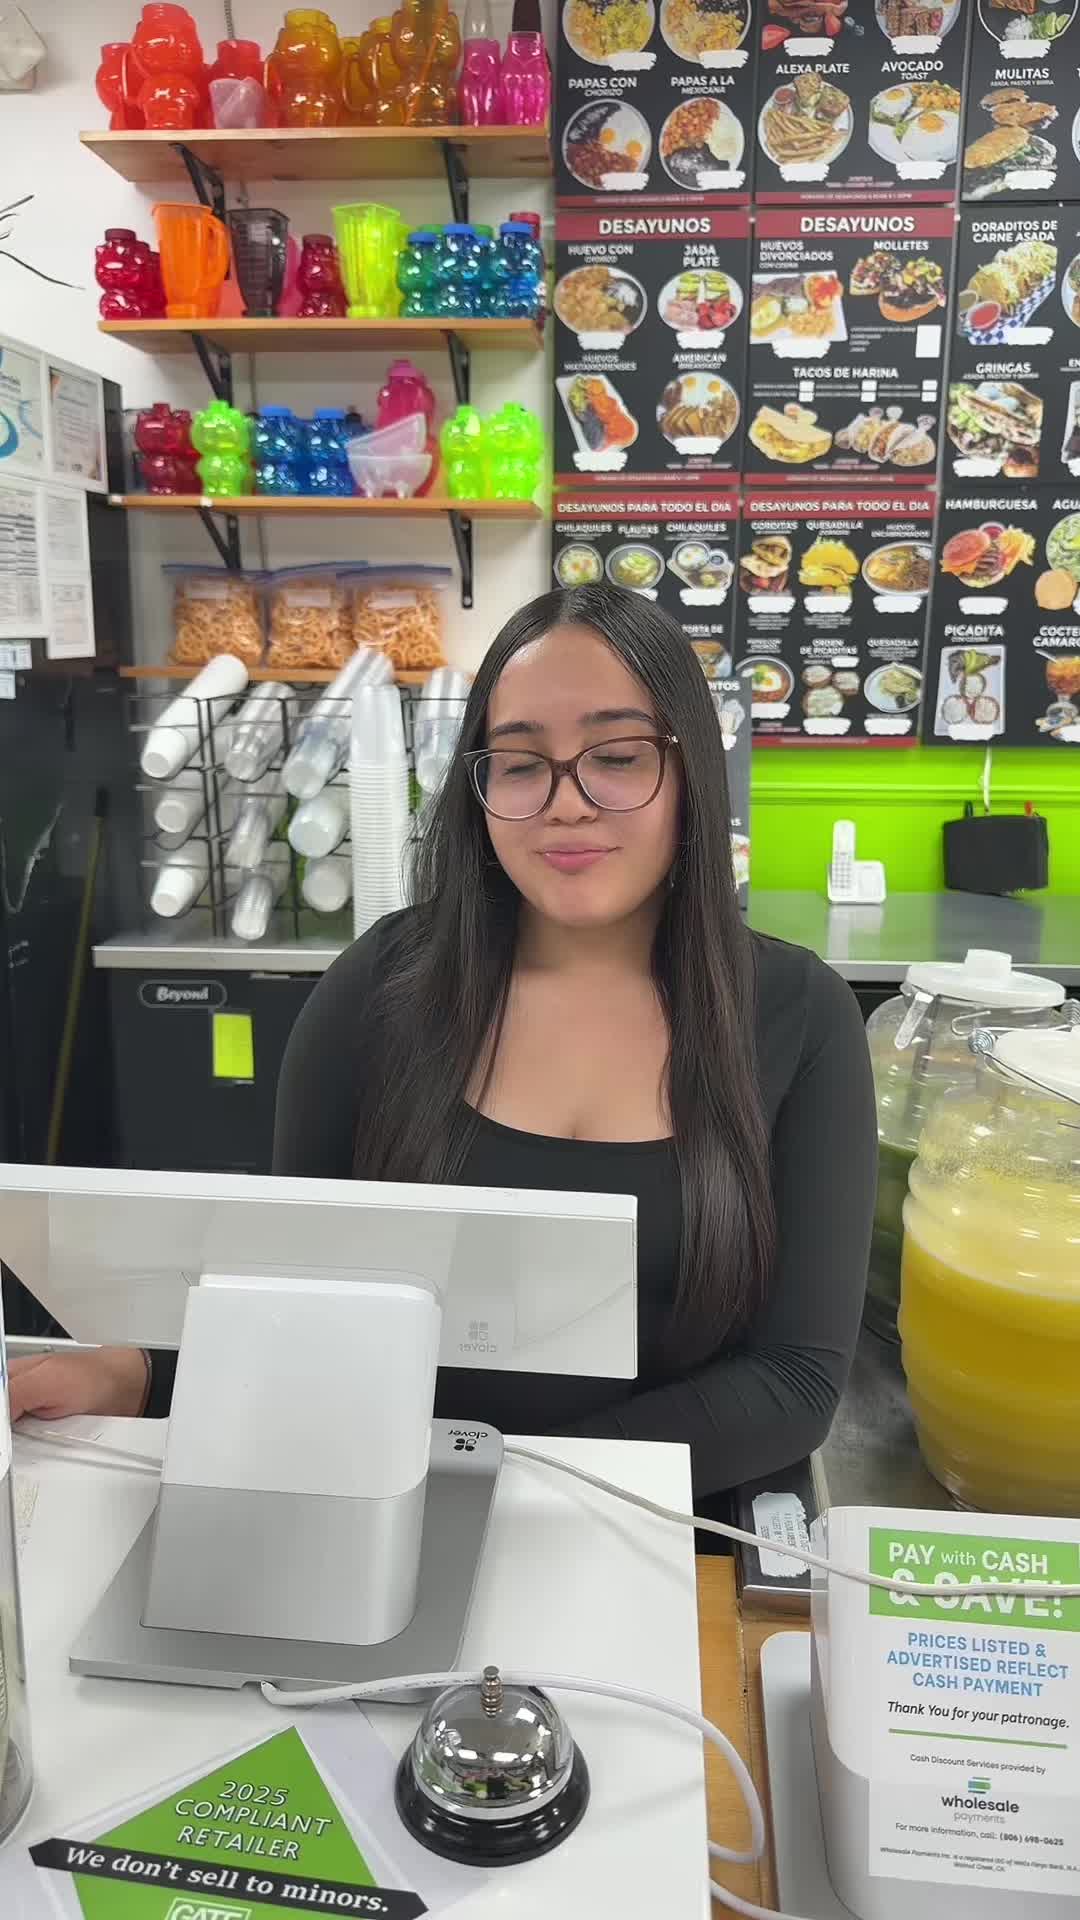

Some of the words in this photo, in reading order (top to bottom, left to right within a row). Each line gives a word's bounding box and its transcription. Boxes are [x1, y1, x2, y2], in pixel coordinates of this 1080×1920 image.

[775, 64, 812, 75] ALEXA
[815, 63, 850, 74] PLATE
[881, 60, 944, 73] AVOCADO
[900, 72, 929, 81] TOAST
[994, 68, 1050, 80] MULITAS
[568, 78, 607, 89] PAPAS
[609, 77, 637, 88] CON
[670, 77, 708, 87] PAPAS
[709, 76, 718, 86] A
[720, 75, 735, 86] LA
[681, 86, 726, 95] MEXICANA
[599, 217, 711, 235] DESAYUNOS
[800, 216, 915, 233] DESAYUNOS
[971, 221, 1040, 233] DORADITOS
[1041, 220, 1058, 232] DE
[973, 231, 1013, 243] CARNE
[1014, 231, 1055, 242] ASADA
[567, 245, 606, 256] HUEVO
[608, 244, 634, 256] CON
[684, 244, 716, 257] JADA
[760, 241, 804, 251] HUEVOS
[873, 240, 929, 251] MOLLETES
[683, 256, 720, 268] PLATE
[759, 251, 834, 262] DIVORCIADOS
[672, 353, 727, 364] AMERICAN
[792, 367, 831, 379] TACOS
[833, 367, 850, 379] DE
[852, 367, 899, 378] HARINA
[975, 362, 1031, 375] GRINGAS
[557, 503, 626, 513] DESAYUNOS
[627, 503, 658, 513] PARA
[661, 502, 693, 513] TODO
[695, 502, 708, 512] EL
[711, 502, 731, 512] DIA
[750, 501, 819, 512] DESAYUNOS
[821, 501, 853, 511] PARA
[856, 501, 890, 511] TODO
[892, 501, 907, 511] EL
[908, 501, 930, 511] DIA
[945, 499, 1038, 511] HAMBURGUESA
[555, 523, 613, 533] CHILAQUILES
[666, 522, 727, 533] CHILAQUILES
[806, 521, 864, 531] QUESADILLA
[711, 624, 724, 634] DE
[944, 625, 1004, 637] PICADITA
[867, 639, 919, 647] QUESADILLA
[156, 986, 209, 1002] Beyond
[447, 1429, 489, 1439] clover
[888, 1541, 936, 1566] PAY
[941, 1550, 976, 1566] with
[982, 1549, 1049, 1575] CASH
[888, 1568, 920, 1607] &
[907, 1632, 968, 1651] PRICES
[971, 1637, 1030, 1657] LISTED
[1035, 1643, 1047, 1658] &
[887, 1650, 992, 1673] ADVERTISED
[996, 1659, 1069, 1680] REFLECT
[912, 1672, 960, 1690] CASH
[963, 1676, 1043, 1697] PAYMENT
[887, 1701, 925, 1715] Thank
[927, 1704, 950, 1717] You
[951, 1706, 970, 1720] for
[971, 1710, 1000, 1722] your
[1001, 1711, 1070, 1730] patronage.
[910, 1754, 930, 1764] Cash
[931, 1756, 965, 1767] Discount
[966, 1759, 1000, 1770] Services
[1000, 1762, 1035, 1774] provided
[1036, 1765, 1046, 1775] by
[218, 1781, 289, 1806] 2025
[941, 1795, 1020, 1813] wholesale
[174, 1799, 333, 1837] COMPLIANT
[953, 1811, 1006, 1825] payments
[895, 1822, 908, 1831] For
[909, 1825, 930, 1833] more
[930, 1826, 979, 1839] information,
[999, 1832, 1023, 1843] (806)
[176, 1825, 301, 1860] RETAILER
[66, 1847, 106, 1868] We
[111, 1854, 183, 1881] don't
[186, 1869, 240, 1889] sell
[245, 1875, 274, 1895] to
[280, 1884, 389, 1913] minors.
